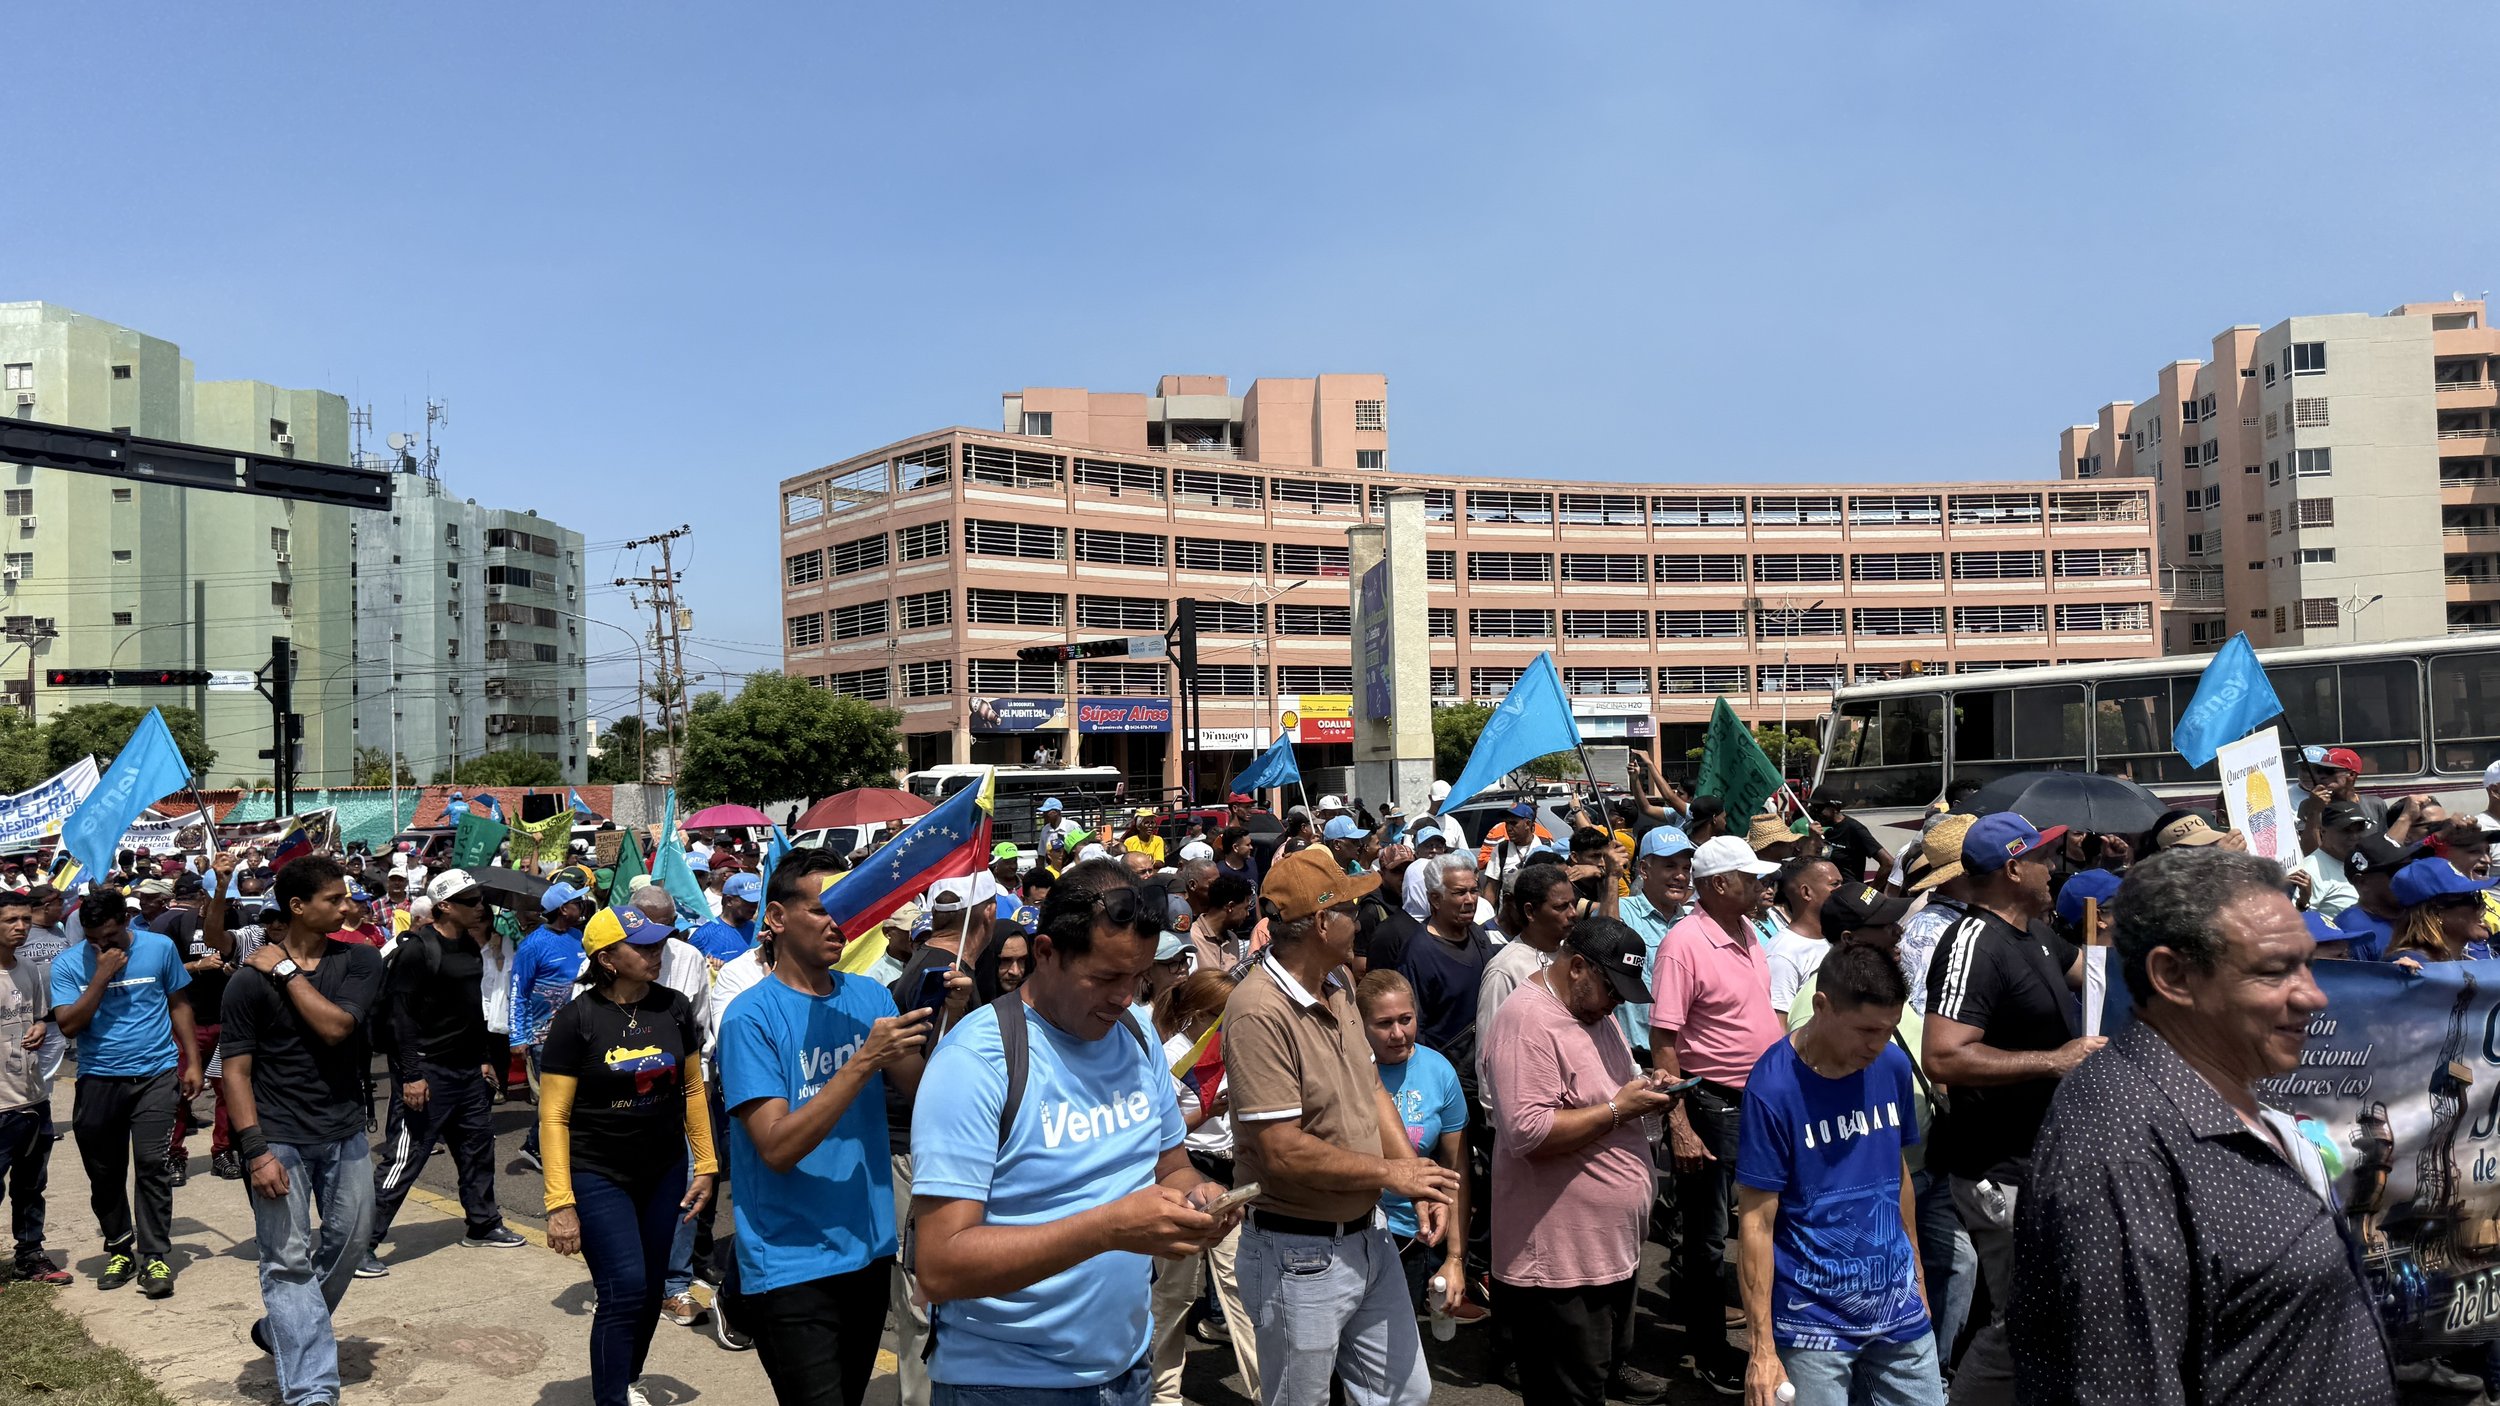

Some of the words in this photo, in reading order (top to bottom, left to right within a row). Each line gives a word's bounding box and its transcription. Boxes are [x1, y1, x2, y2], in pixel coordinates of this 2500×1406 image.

[1000, 708, 1011, 718] DEL
[1011, 708, 1033, 718] PUENTE
[1079, 705, 1127, 725] Súper
[2226, 761, 2260, 786] Queremos
[2260, 755, 2279, 770] votar
[798, 1033, 865, 1081] Vent
[2335, 1074, 2373, 1101] (as)
[1040, 1090, 1150, 1150] Vente
[1804, 1101, 1900, 1149] JORDAN
[2472, 1147, 2497, 1185] de
[1792, 1333, 1839, 1351] NIKE
